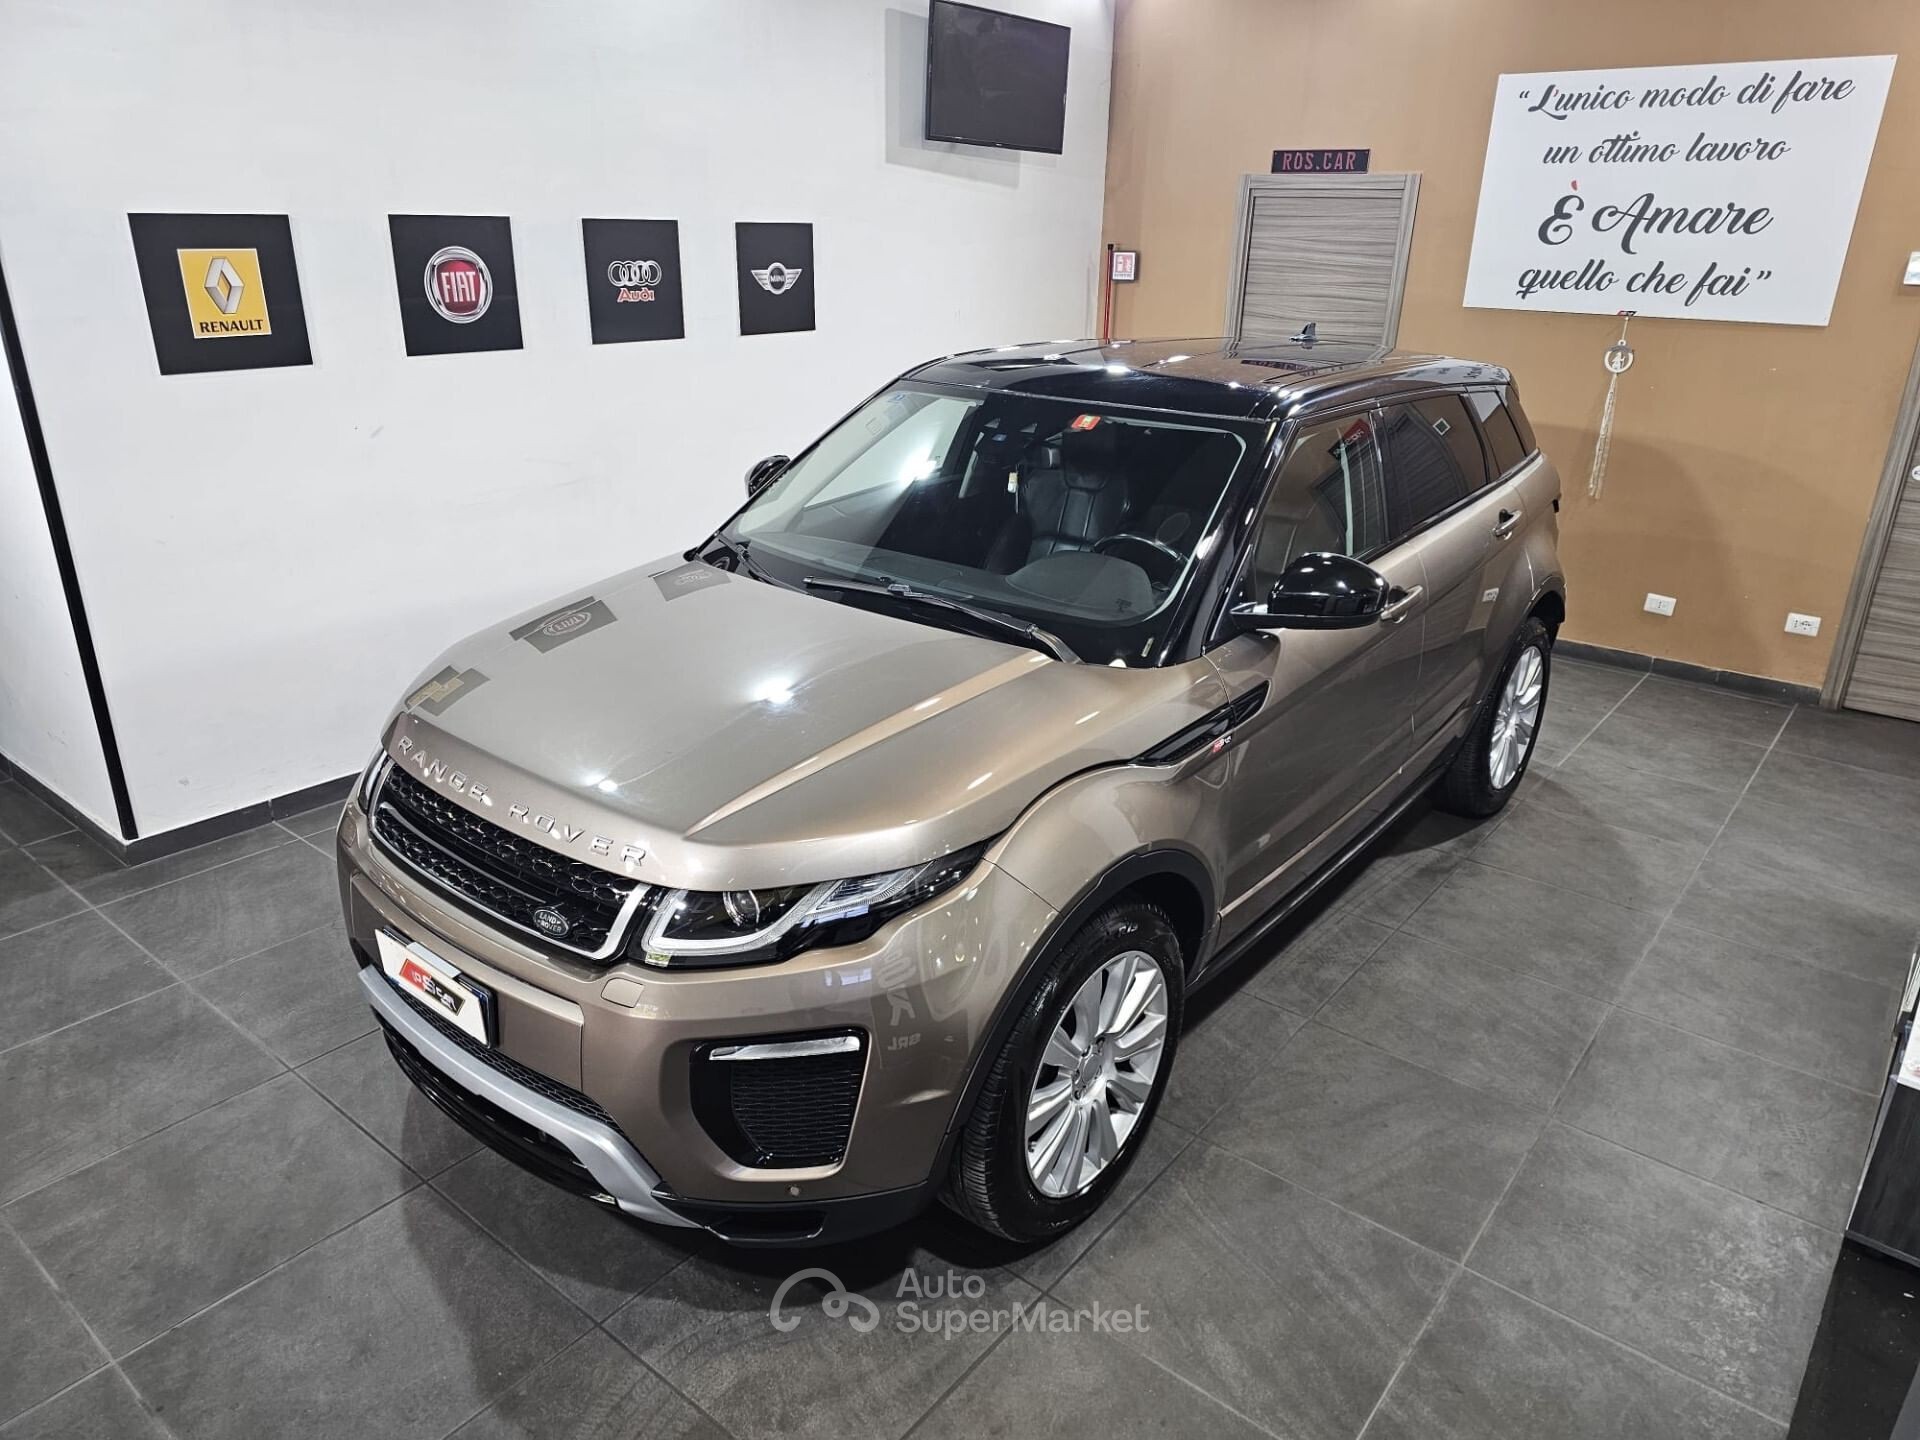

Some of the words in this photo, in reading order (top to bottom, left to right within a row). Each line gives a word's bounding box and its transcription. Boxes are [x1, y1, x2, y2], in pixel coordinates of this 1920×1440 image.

[1639, 75, 1730, 109] modo
[1737, 71, 1776, 105] di
[1771, 70, 1855, 114] fare
[1282, 151, 1357, 171] ROS.CAR
[1542, 144, 1582, 165] un
[1588, 131, 1680, 164] ottimo
[1685, 132, 1791, 162] lavoro
[1537, 180, 1585, 246] È
[1591, 192, 1774, 256] Amare
[440, 270, 477, 305] FIAT
[617, 287, 655, 302] Audi
[1515, 258, 1618, 300] quello
[1625, 260, 1687, 296] che
[199, 318, 264, 335] RENAULT
[398, 735, 490, 803] RANGE
[508, 801, 647, 867] ROVER
